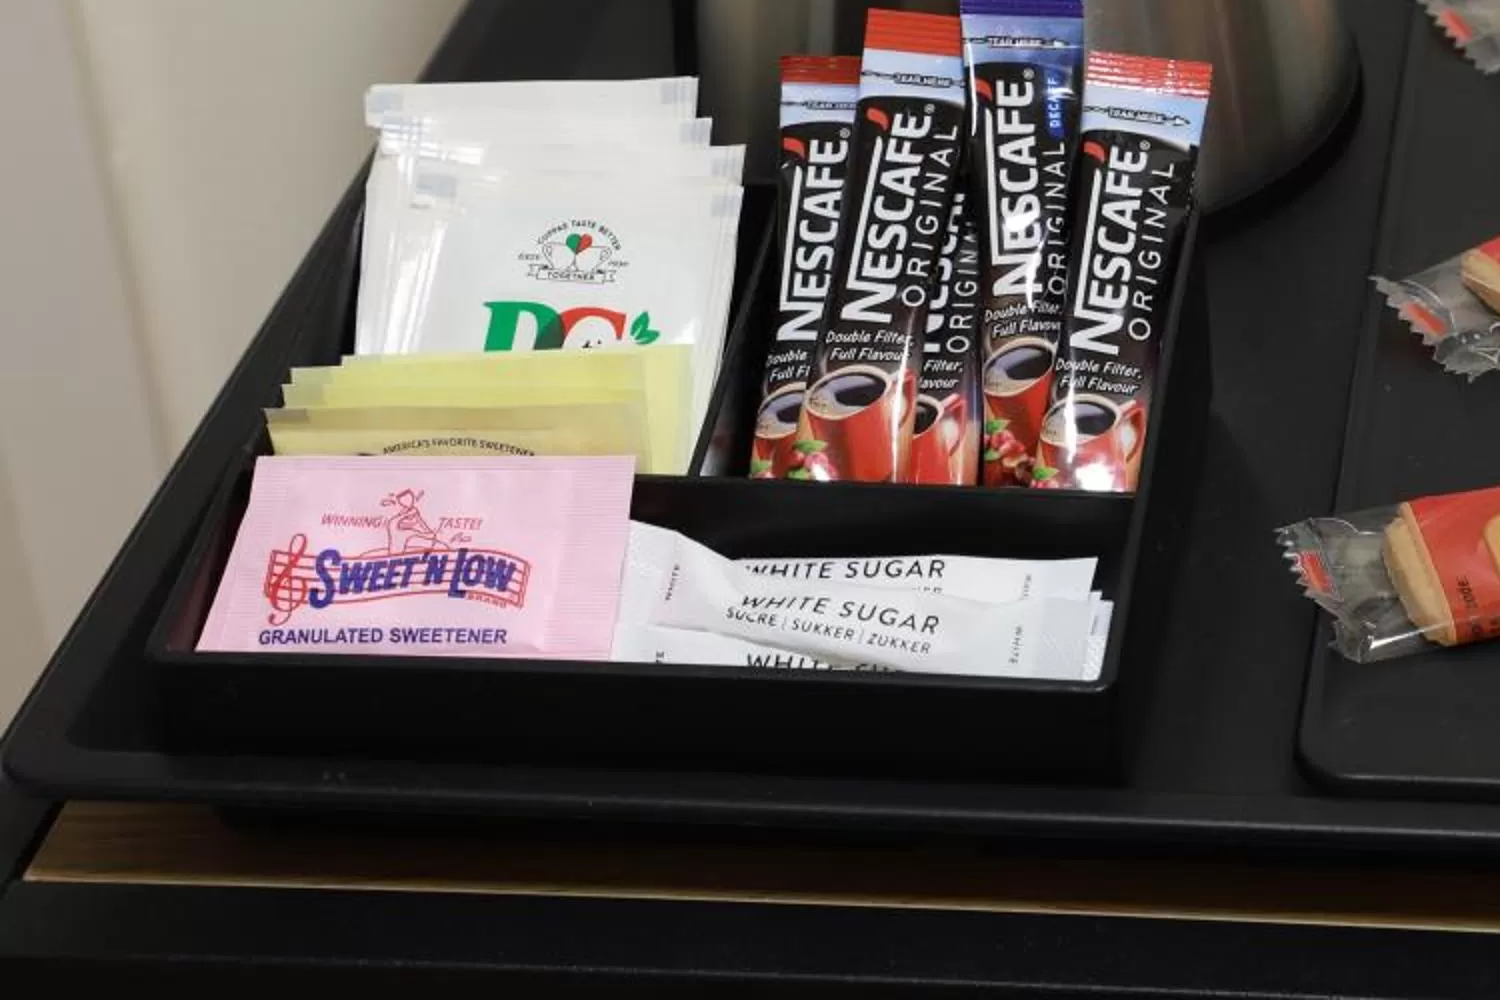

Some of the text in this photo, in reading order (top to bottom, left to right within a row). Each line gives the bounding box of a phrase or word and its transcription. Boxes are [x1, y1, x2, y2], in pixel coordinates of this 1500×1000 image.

[902, 125, 958, 307] ORIGINAL
[1043, 142, 1067, 295] ORIGINAL
[1128, 163, 1174, 341] ORIGINAL
[826, 329, 872, 344] Double
[992, 325, 1017, 338] Full
[830, 347, 857, 361] Full
[1056, 357, 1099, 373] Double
[769, 366, 794, 382] Full
[918, 376, 959, 390] lavour
[1060, 376, 1140, 394] Full Flavour
[431, 437, 478, 448] FAVORITE
[745, 558, 946, 580] WHITE SUGAR
[742, 595, 940, 635] WHITE SUGAR
[258, 628, 508, 645] GRANULATED SWEETENER
[726, 607, 931, 655] SUCRE SUKKER ZUKKER
